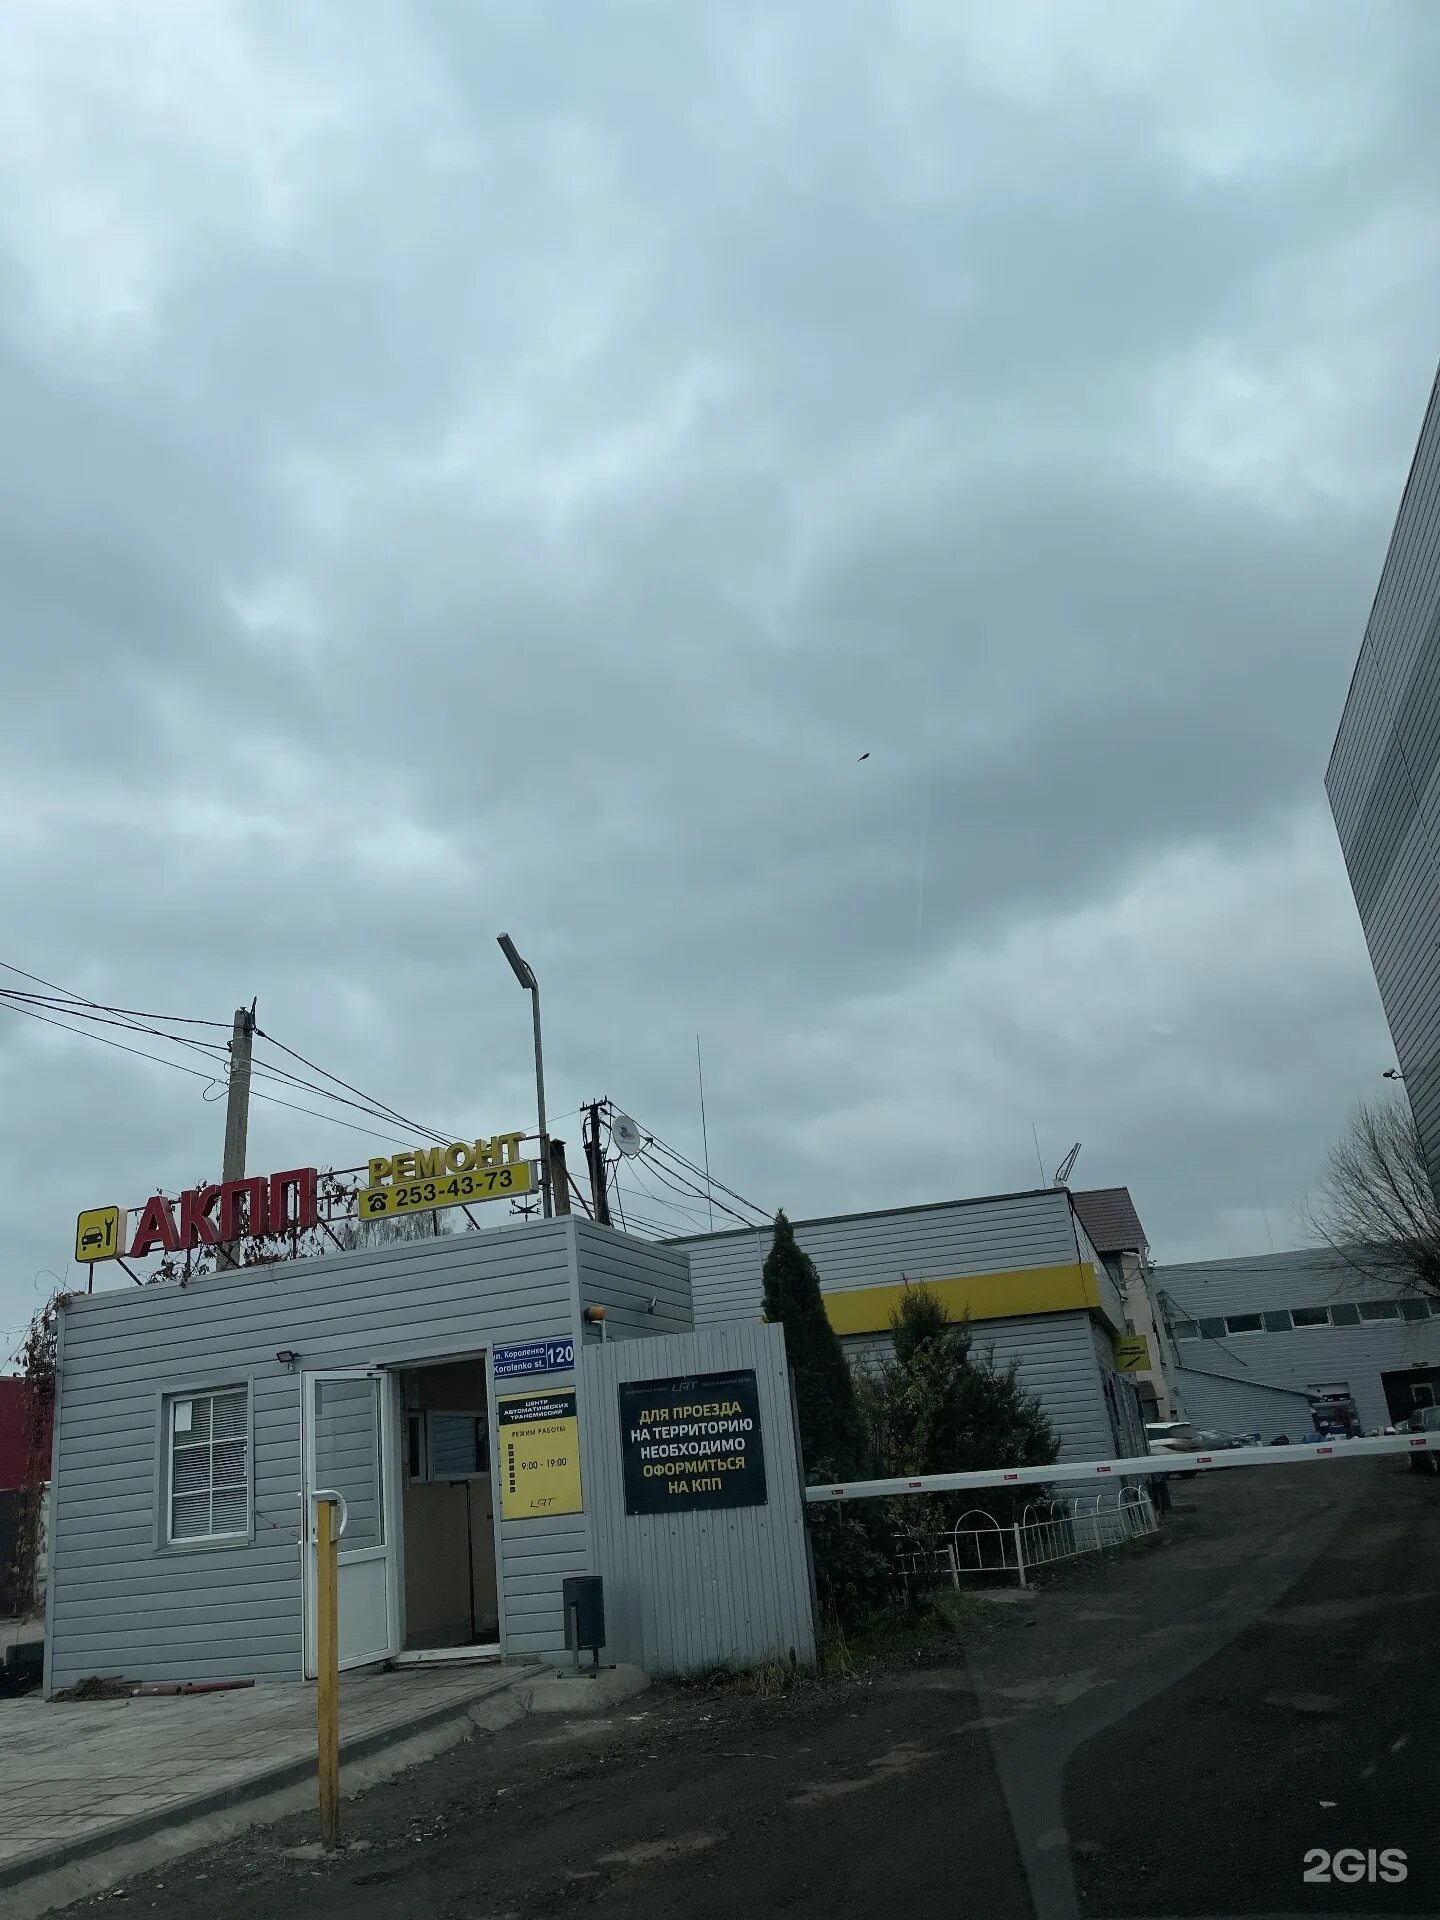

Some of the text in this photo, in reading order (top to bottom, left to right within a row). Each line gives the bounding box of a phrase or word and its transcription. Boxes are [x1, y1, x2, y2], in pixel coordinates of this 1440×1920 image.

[368, 1131, 526, 1189] РЕМОНТ
[396, 1169, 512, 1207] 253-43-73
[130, 1167, 317, 1258] АКПП
[504, 1347, 545, 1359] Короленко
[547, 1345, 574, 1364] 120
[494, 1361, 532, 1373] Korolenko
[503, 1403, 569, 1416] АВТОМАТИЧЕСКИХ
[510, 1409, 563, 1420] ТРАНСМИССИЙ
[639, 1401, 742, 1425] ДЛЯ ПРОЕЗДА
[511, 1426, 567, 1438] РЕЖИМ РАБОТЫ
[630, 1418, 753, 1443] НА ТЕРРИТОРИЮ
[640, 1437, 746, 1459] НЕОБХОДИМО
[521, 1460, 538, 1471] 9:00
[546, 1457, 567, 1468] 19:00
[642, 1456, 746, 1477] ОФОРМИТЬСЯ
[668, 1477, 722, 1494] НА КПП
